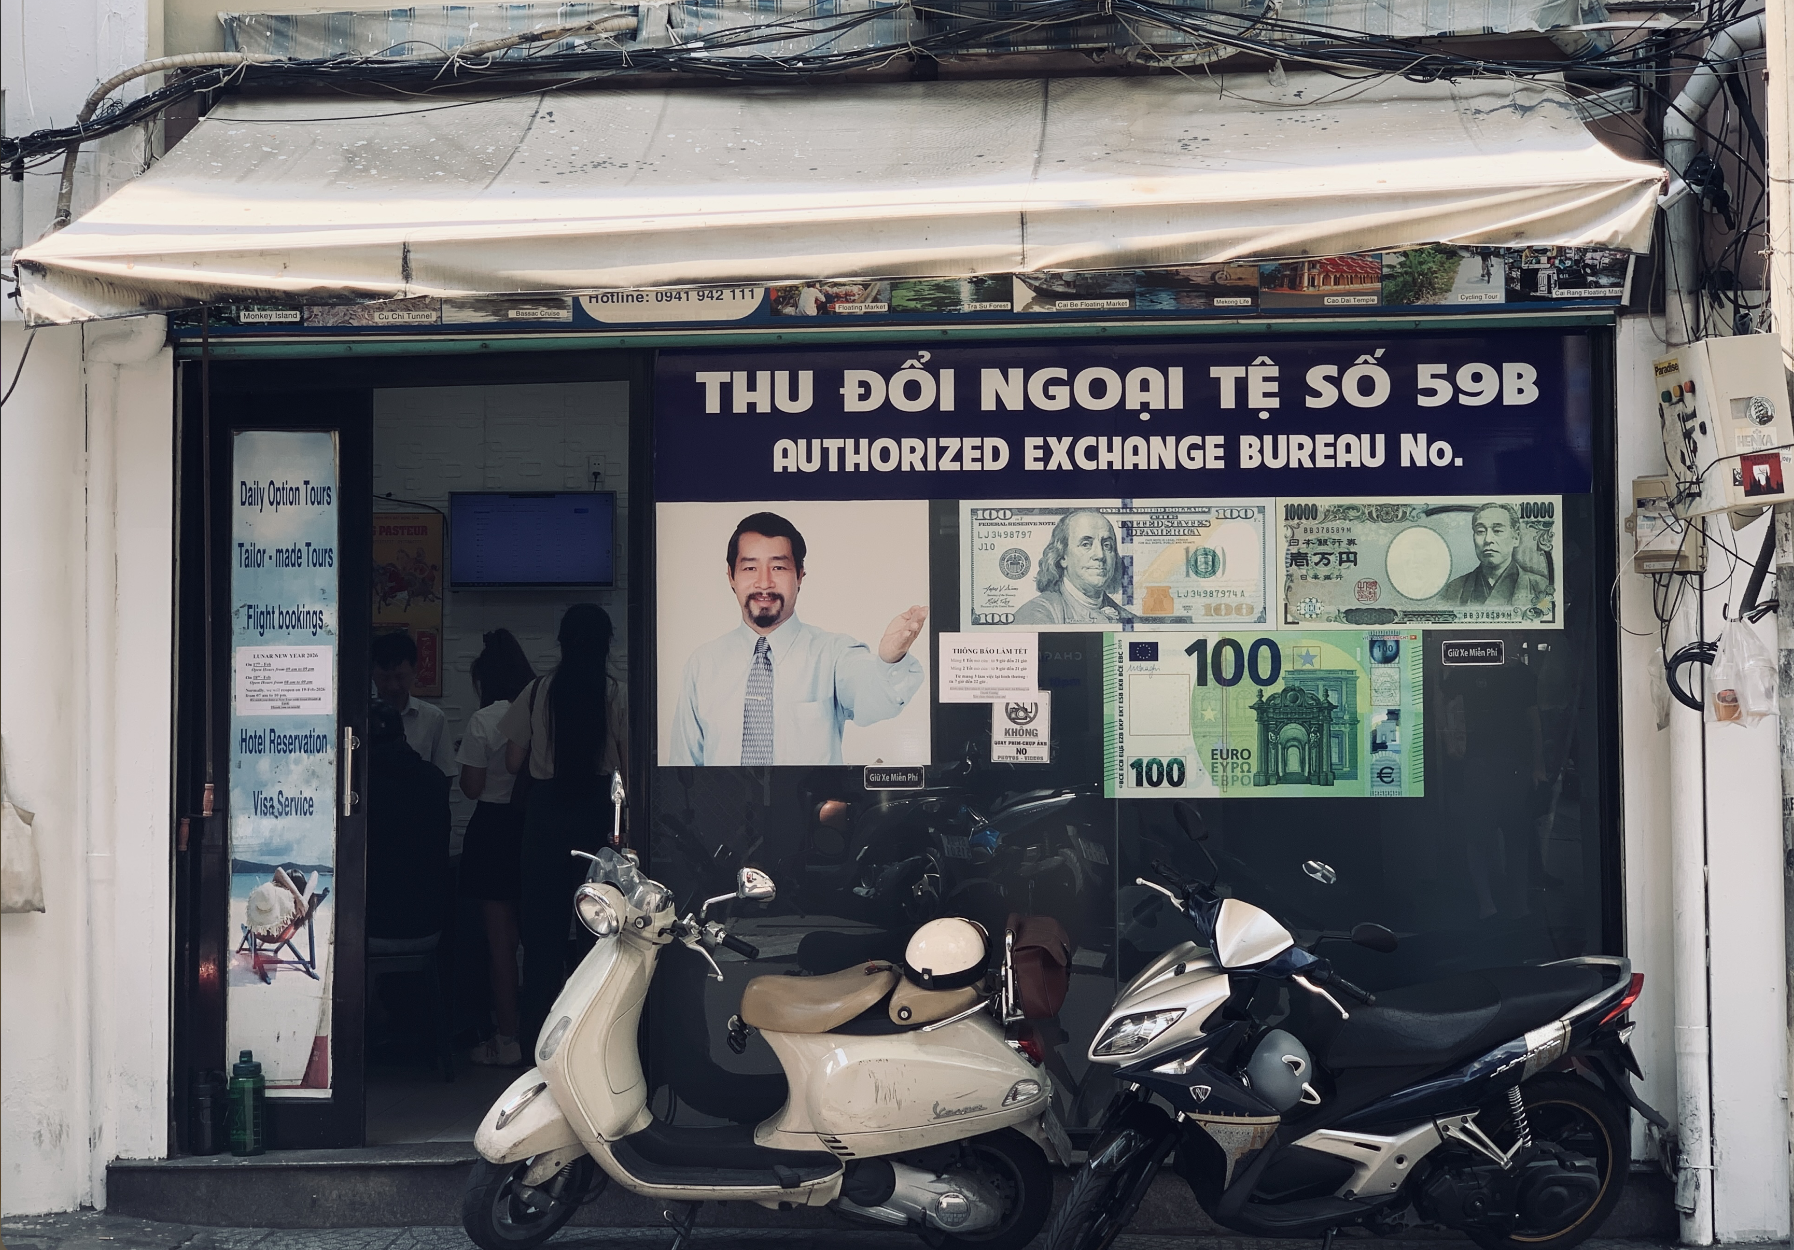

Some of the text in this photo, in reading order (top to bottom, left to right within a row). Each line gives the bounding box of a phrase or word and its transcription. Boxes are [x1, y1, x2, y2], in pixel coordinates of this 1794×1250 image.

[588, 288, 755, 304] Hotline: 0941 942 111
[1352, 297, 1376, 305] Temple
[837, 303, 886, 312] Floating Market
[1077, 301, 1104, 309] Floating
[1106, 300, 1128, 308] Market
[243, 312, 273, 321] Monkey
[407, 312, 433, 320] Tunnel
[1654, 362, 1679, 377] Paradise
[695, 348, 1539, 421] THU ĐỔI NGOẠI TỆ SỐ 59B
[773, 433, 1463, 473] AUTHORIZED EXCHANGE BUREAU No.
[240, 480, 332, 514] Daily Option Tours
[975, 509, 1013, 521] 100
[1215, 508, 1255, 520] 100
[1284, 503, 1318, 521] 10000
[1519, 502, 1554, 519] 10000
[379, 525, 428, 536] PASTEUR
[978, 542, 996, 551] J10
[1289, 538, 1357, 547] 日本銀行券
[237, 542, 266, 569] Tailor
[275, 542, 303, 568] made
[305, 542, 334, 568] Tours
[1289, 550, 1358, 567] 壱万円
[1202, 603, 1255, 617] 100
[246, 604, 324, 638] Flight bookings
[978, 613, 1016, 625] 100
[952, 647, 1028, 655] THÔNG BÁO LÀM TẾT
[1377, 644, 1394, 653] 100
[1448, 647, 1498, 657] Giữ Xe Miễn Phí
[1184, 638, 1282, 687] 100
[1004, 726, 1039, 737] KHÔNG
[240, 728, 328, 755] Hotel Reservation
[1016, 747, 1027, 755] NO
[1211, 748, 1252, 761] EURO
[869, 773, 882, 782] Giữ
[890, 772, 906, 781] Miễn
[907, 774, 919, 782] Phí
[1129, 757, 1186, 788] 100
[1376, 766, 1395, 785] €
[253, 790, 314, 817] Visa Service
